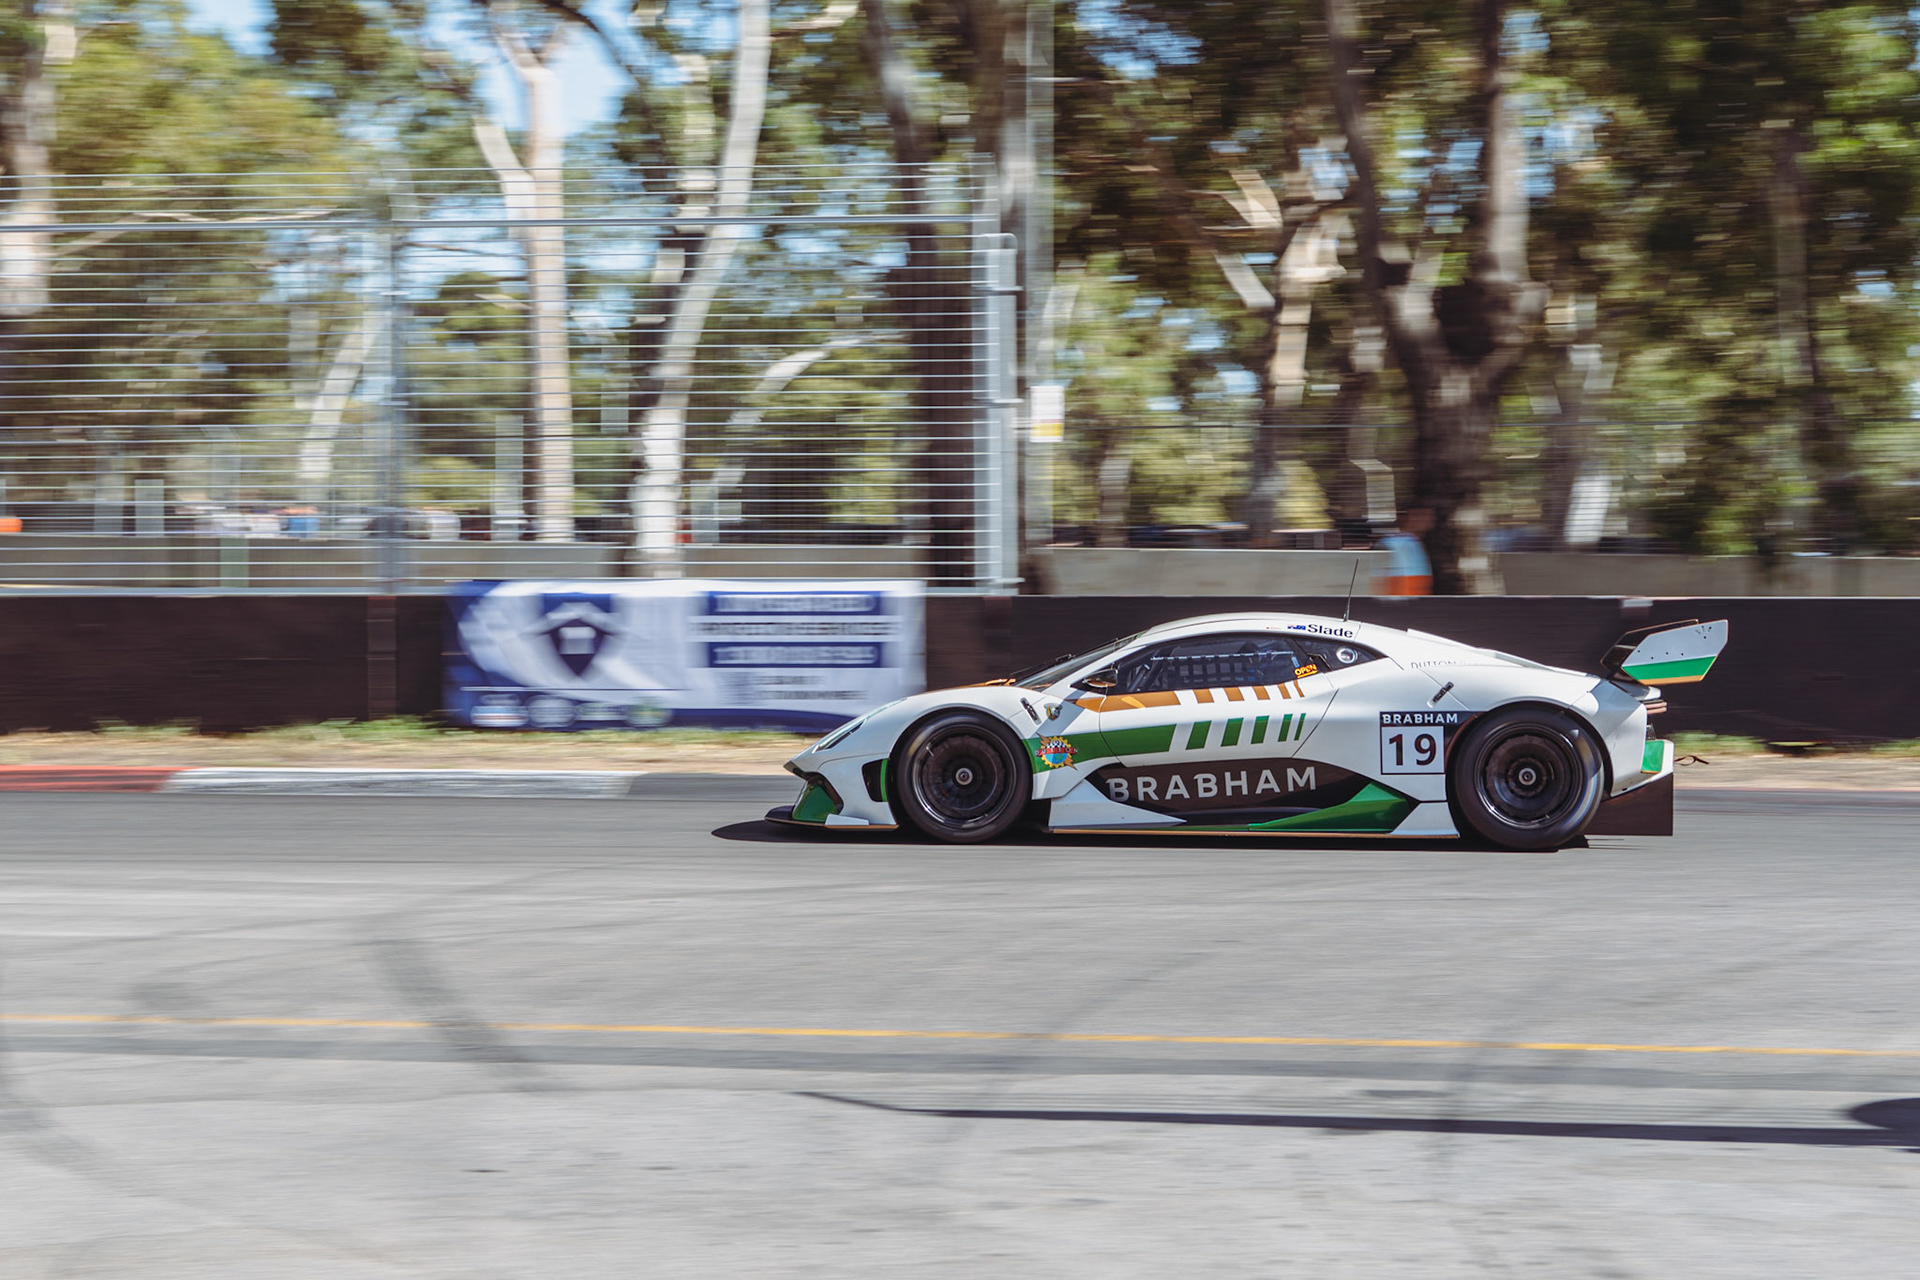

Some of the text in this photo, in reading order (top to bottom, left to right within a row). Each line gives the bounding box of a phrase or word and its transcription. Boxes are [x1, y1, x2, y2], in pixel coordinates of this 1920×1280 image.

[1307, 624, 1354, 638] Slade
[1294, 664, 1318, 676] OPEN
[1381, 713, 1458, 724] BRABHAM
[1389, 733, 1437, 766] 19
[1105, 766, 1316, 801] BRABHAM
